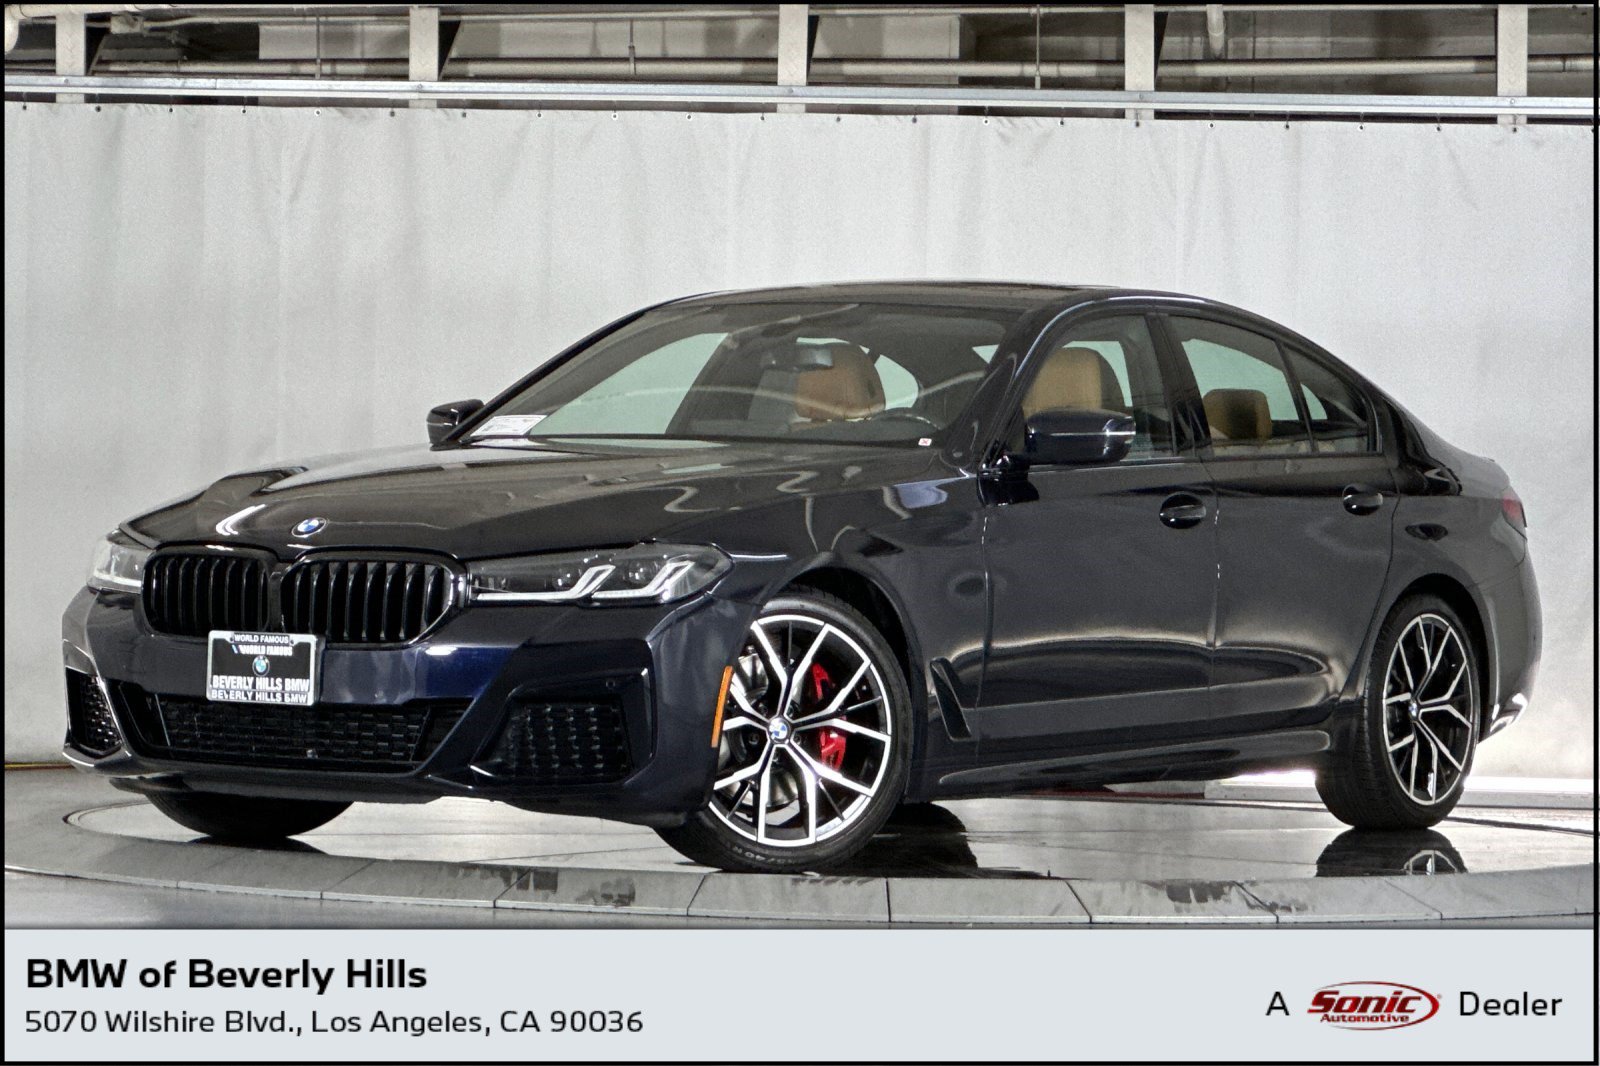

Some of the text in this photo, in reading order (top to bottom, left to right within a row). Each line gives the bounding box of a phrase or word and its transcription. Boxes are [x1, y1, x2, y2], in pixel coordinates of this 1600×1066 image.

[234, 634, 289, 644] WORLD FAMOUS
[212, 675, 309, 692] BEVERLY HILLS BMW
[211, 690, 253, 700] BEVERLY
[256, 691, 282, 702] HILLS
